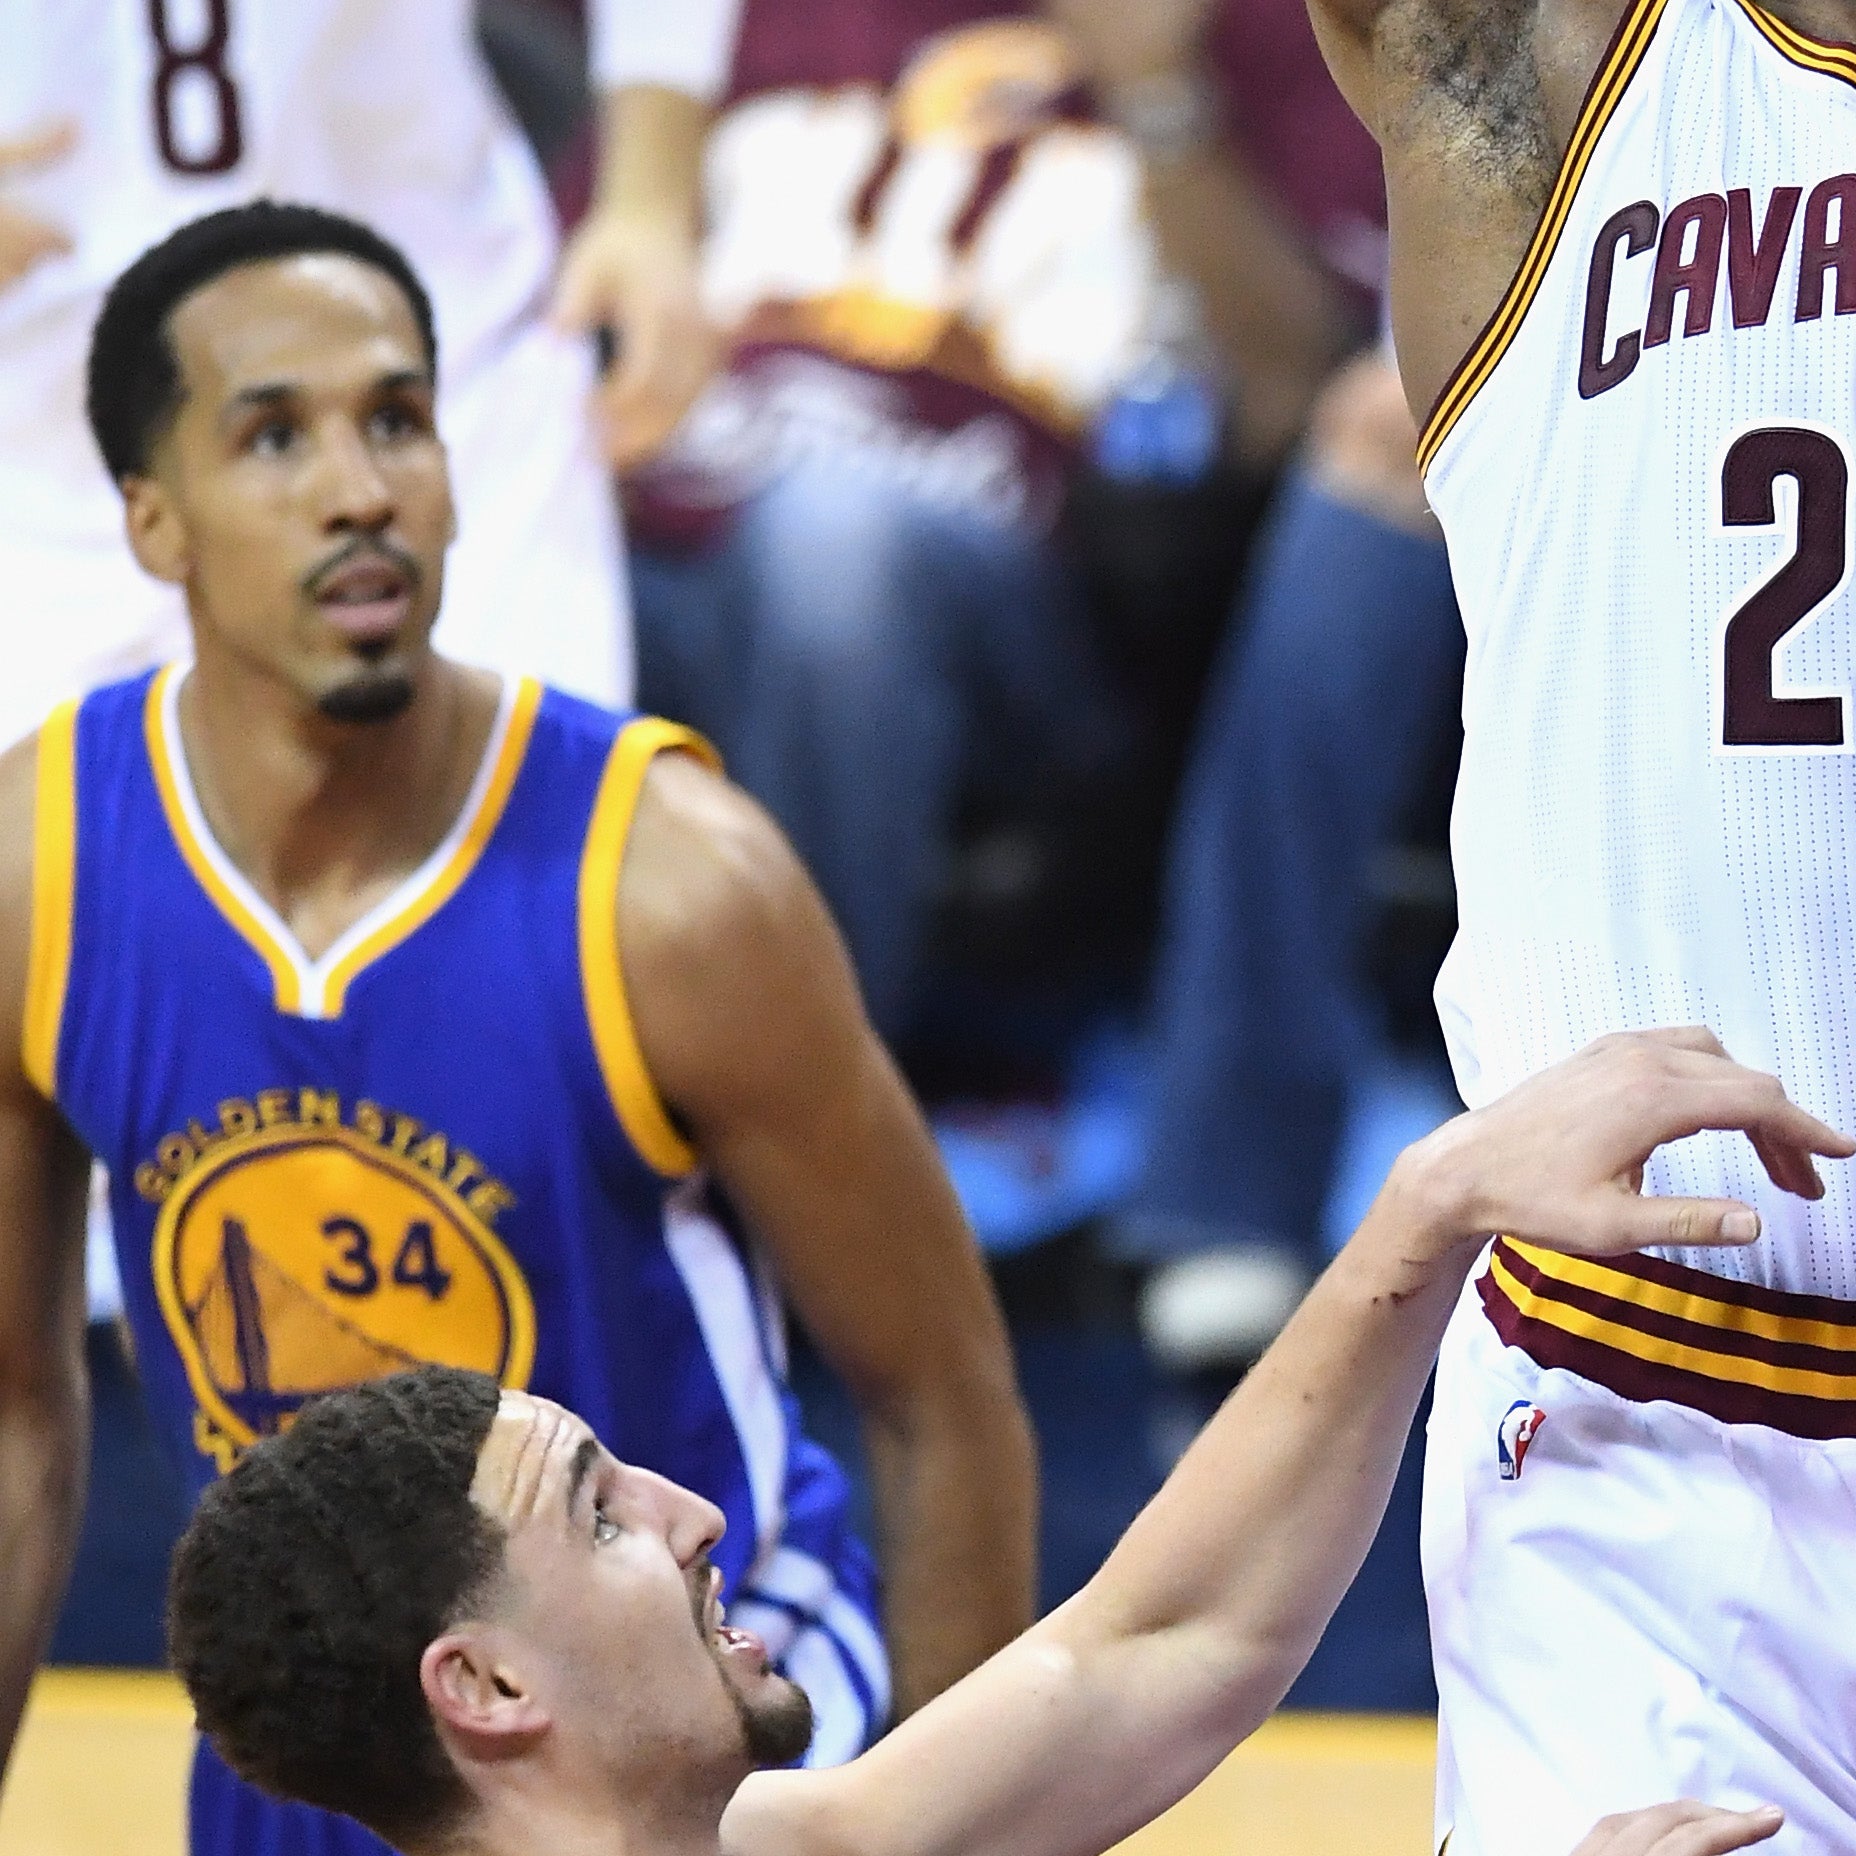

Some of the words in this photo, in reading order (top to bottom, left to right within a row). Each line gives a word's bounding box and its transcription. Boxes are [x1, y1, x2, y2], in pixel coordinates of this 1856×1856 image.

[134, 1087, 341, 1205] GOLDEN
[354, 1099, 517, 1223] STATE
[320, 1214, 452, 1302] 34
